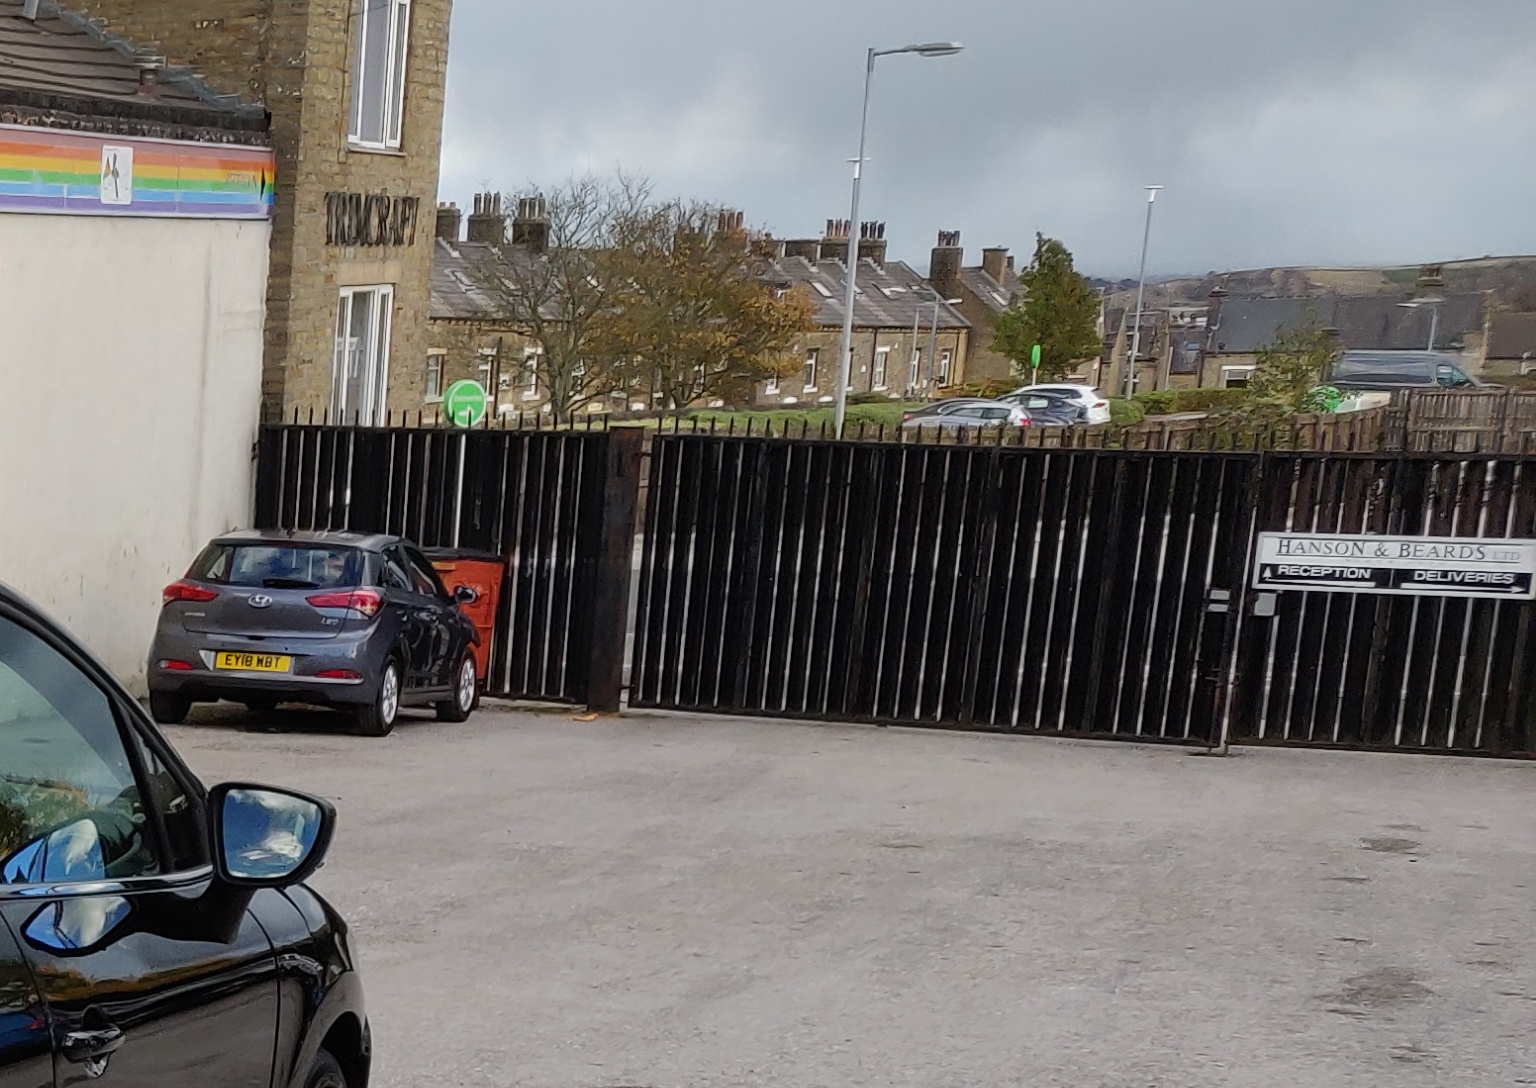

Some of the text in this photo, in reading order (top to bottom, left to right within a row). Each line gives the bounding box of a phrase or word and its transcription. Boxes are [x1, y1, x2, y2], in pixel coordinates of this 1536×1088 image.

[324, 191, 420, 247] TRIMCRAFT
[1276, 539, 1520, 560] HANSON & BEARDS LTD
[1277, 565, 1372, 579] RECEPTION
[1413, 570, 1516, 585] DELIVERIES
[224, 654, 253, 667] EY18
